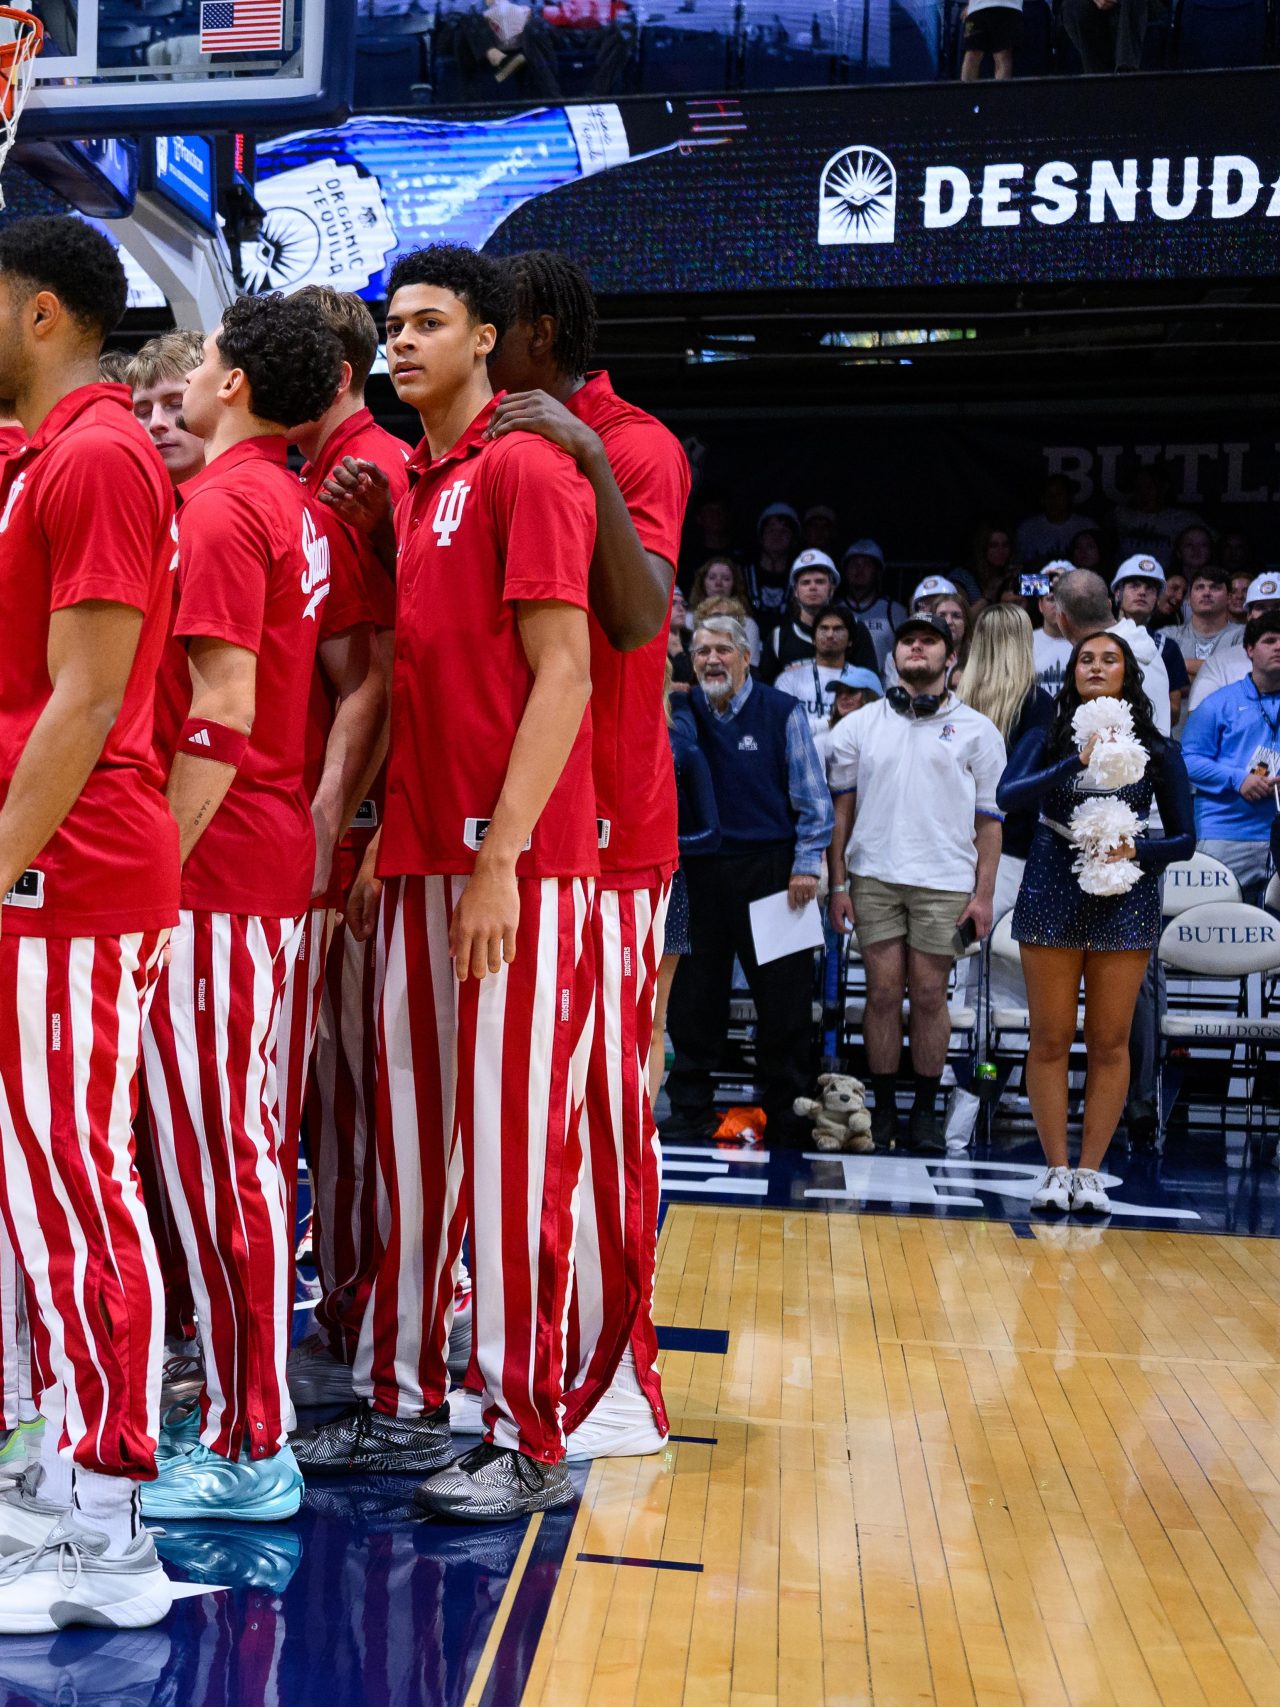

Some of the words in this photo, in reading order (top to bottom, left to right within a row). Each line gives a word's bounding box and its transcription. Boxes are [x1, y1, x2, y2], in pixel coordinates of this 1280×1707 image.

[918, 155, 1280, 228] DESNUD
[1042, 443, 1280, 504] BUTL
[1164, 870, 1230, 888] TLER
[1178, 926, 1276, 944] BUTLER
[623, 946, 632, 977] HOOSIERS
[198, 977, 207, 1012] HOOSIERS
[561, 988, 570, 1022] HOOSIERS
[51, 1013, 61, 1051] HOOSIERS
[1194, 1024, 1280, 1038] BULLDOGS
